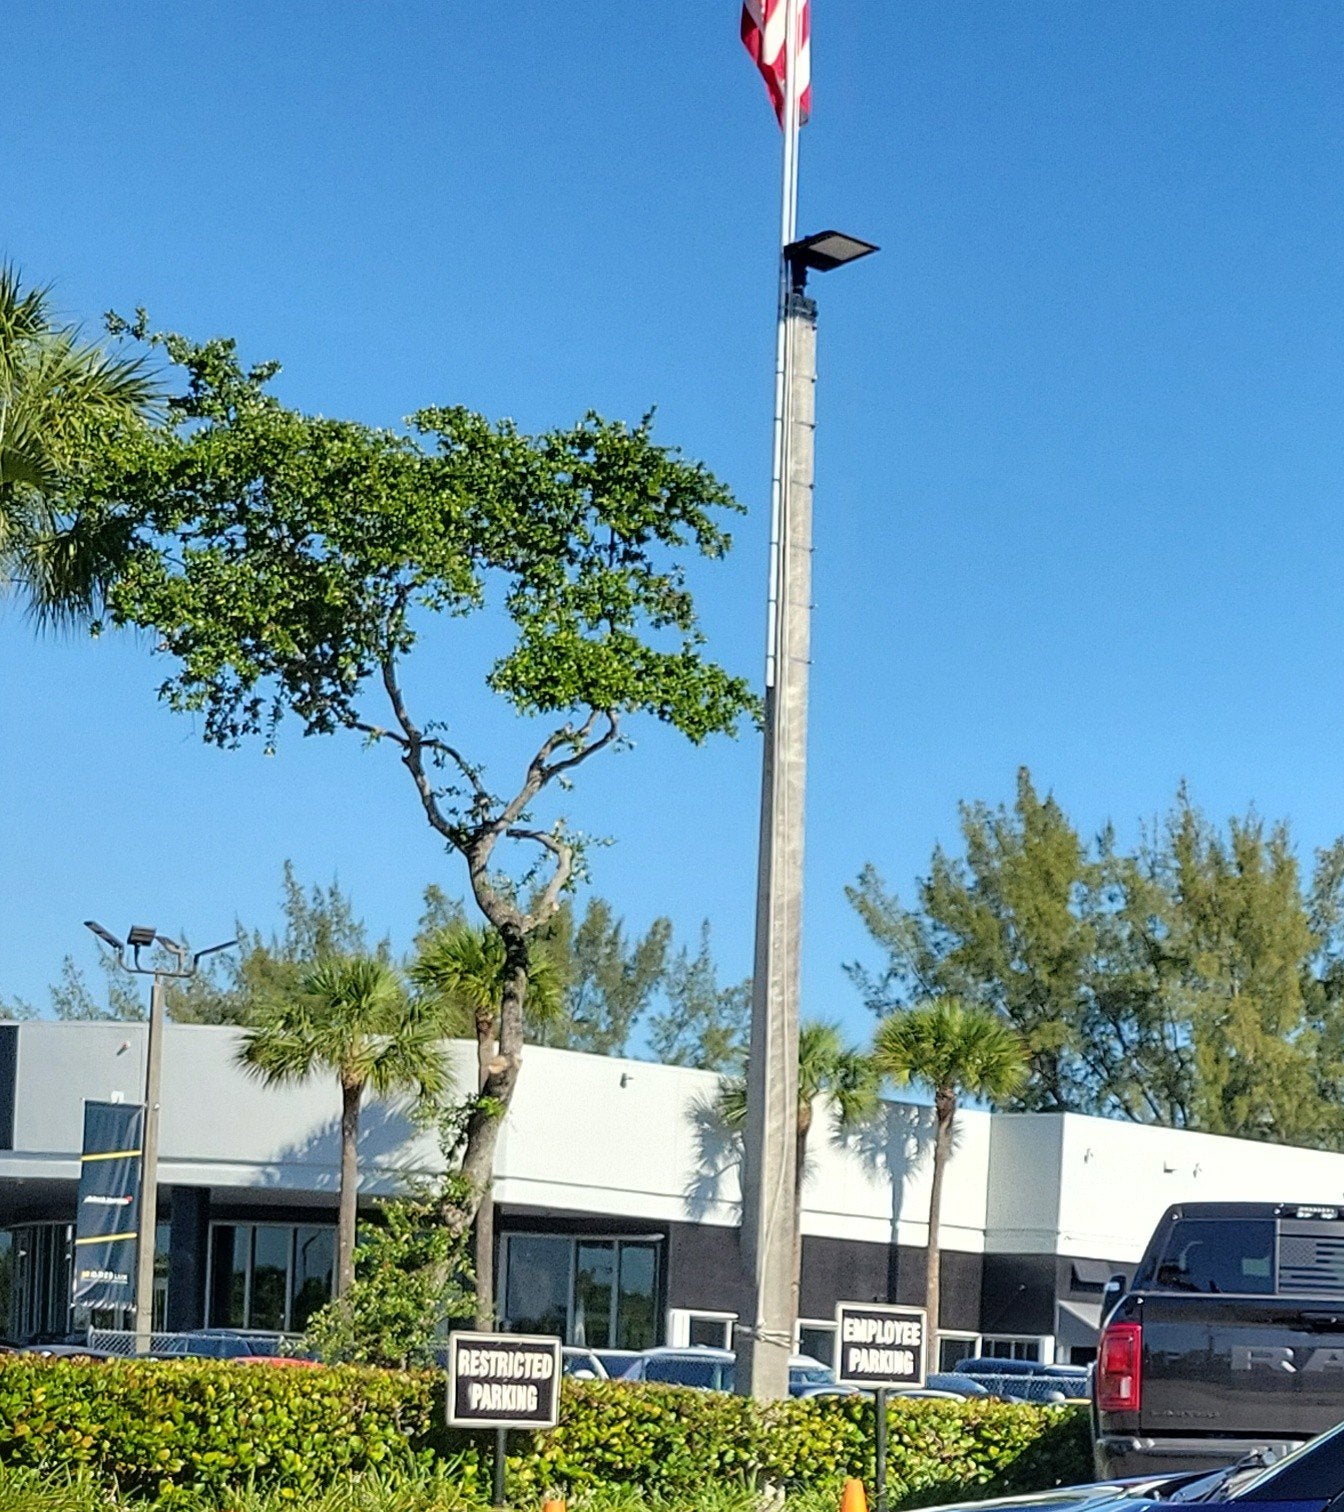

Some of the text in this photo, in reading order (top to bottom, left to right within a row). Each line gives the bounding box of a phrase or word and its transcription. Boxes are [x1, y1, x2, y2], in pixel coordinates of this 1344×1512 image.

[842, 1317, 922, 1345] EMPLOYEE
[457, 1349, 553, 1381] RESTRICTED
[848, 1346, 914, 1375] PARKING
[469, 1382, 537, 1412] PARKING
